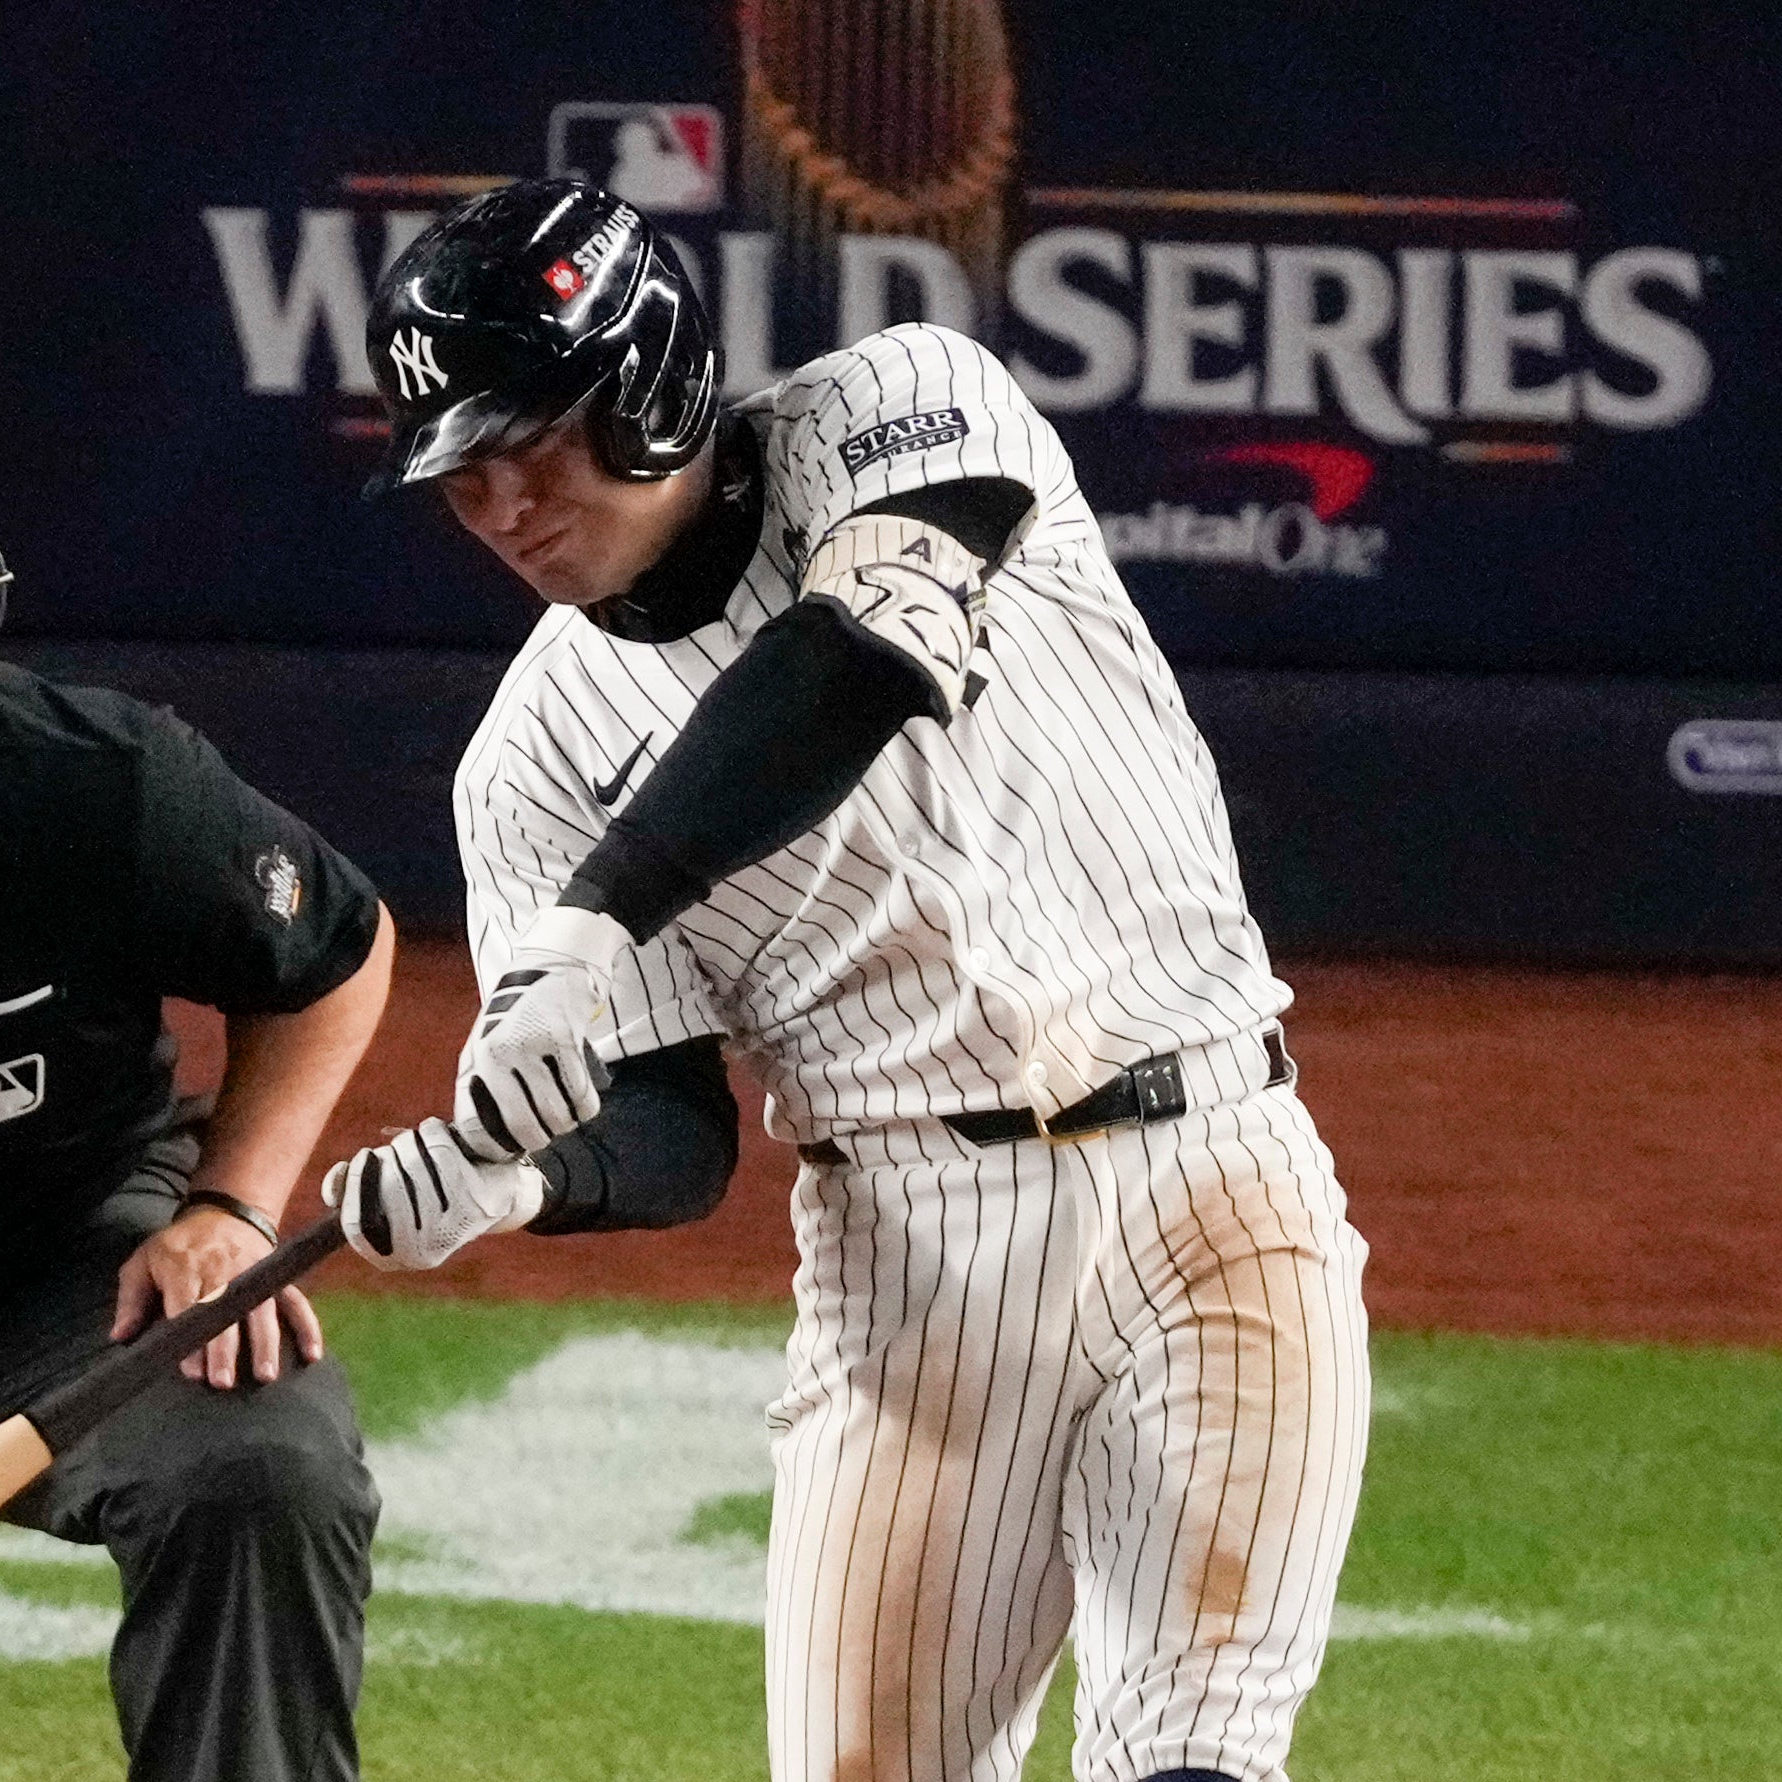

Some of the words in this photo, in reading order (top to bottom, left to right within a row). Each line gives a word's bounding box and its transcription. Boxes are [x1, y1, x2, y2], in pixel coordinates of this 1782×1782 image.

[572, 203, 641, 276] STRAUSS
[202, 206, 976, 396] WLD
[1007, 227, 1711, 444] SERIES
[846, 411, 962, 465] STARR
